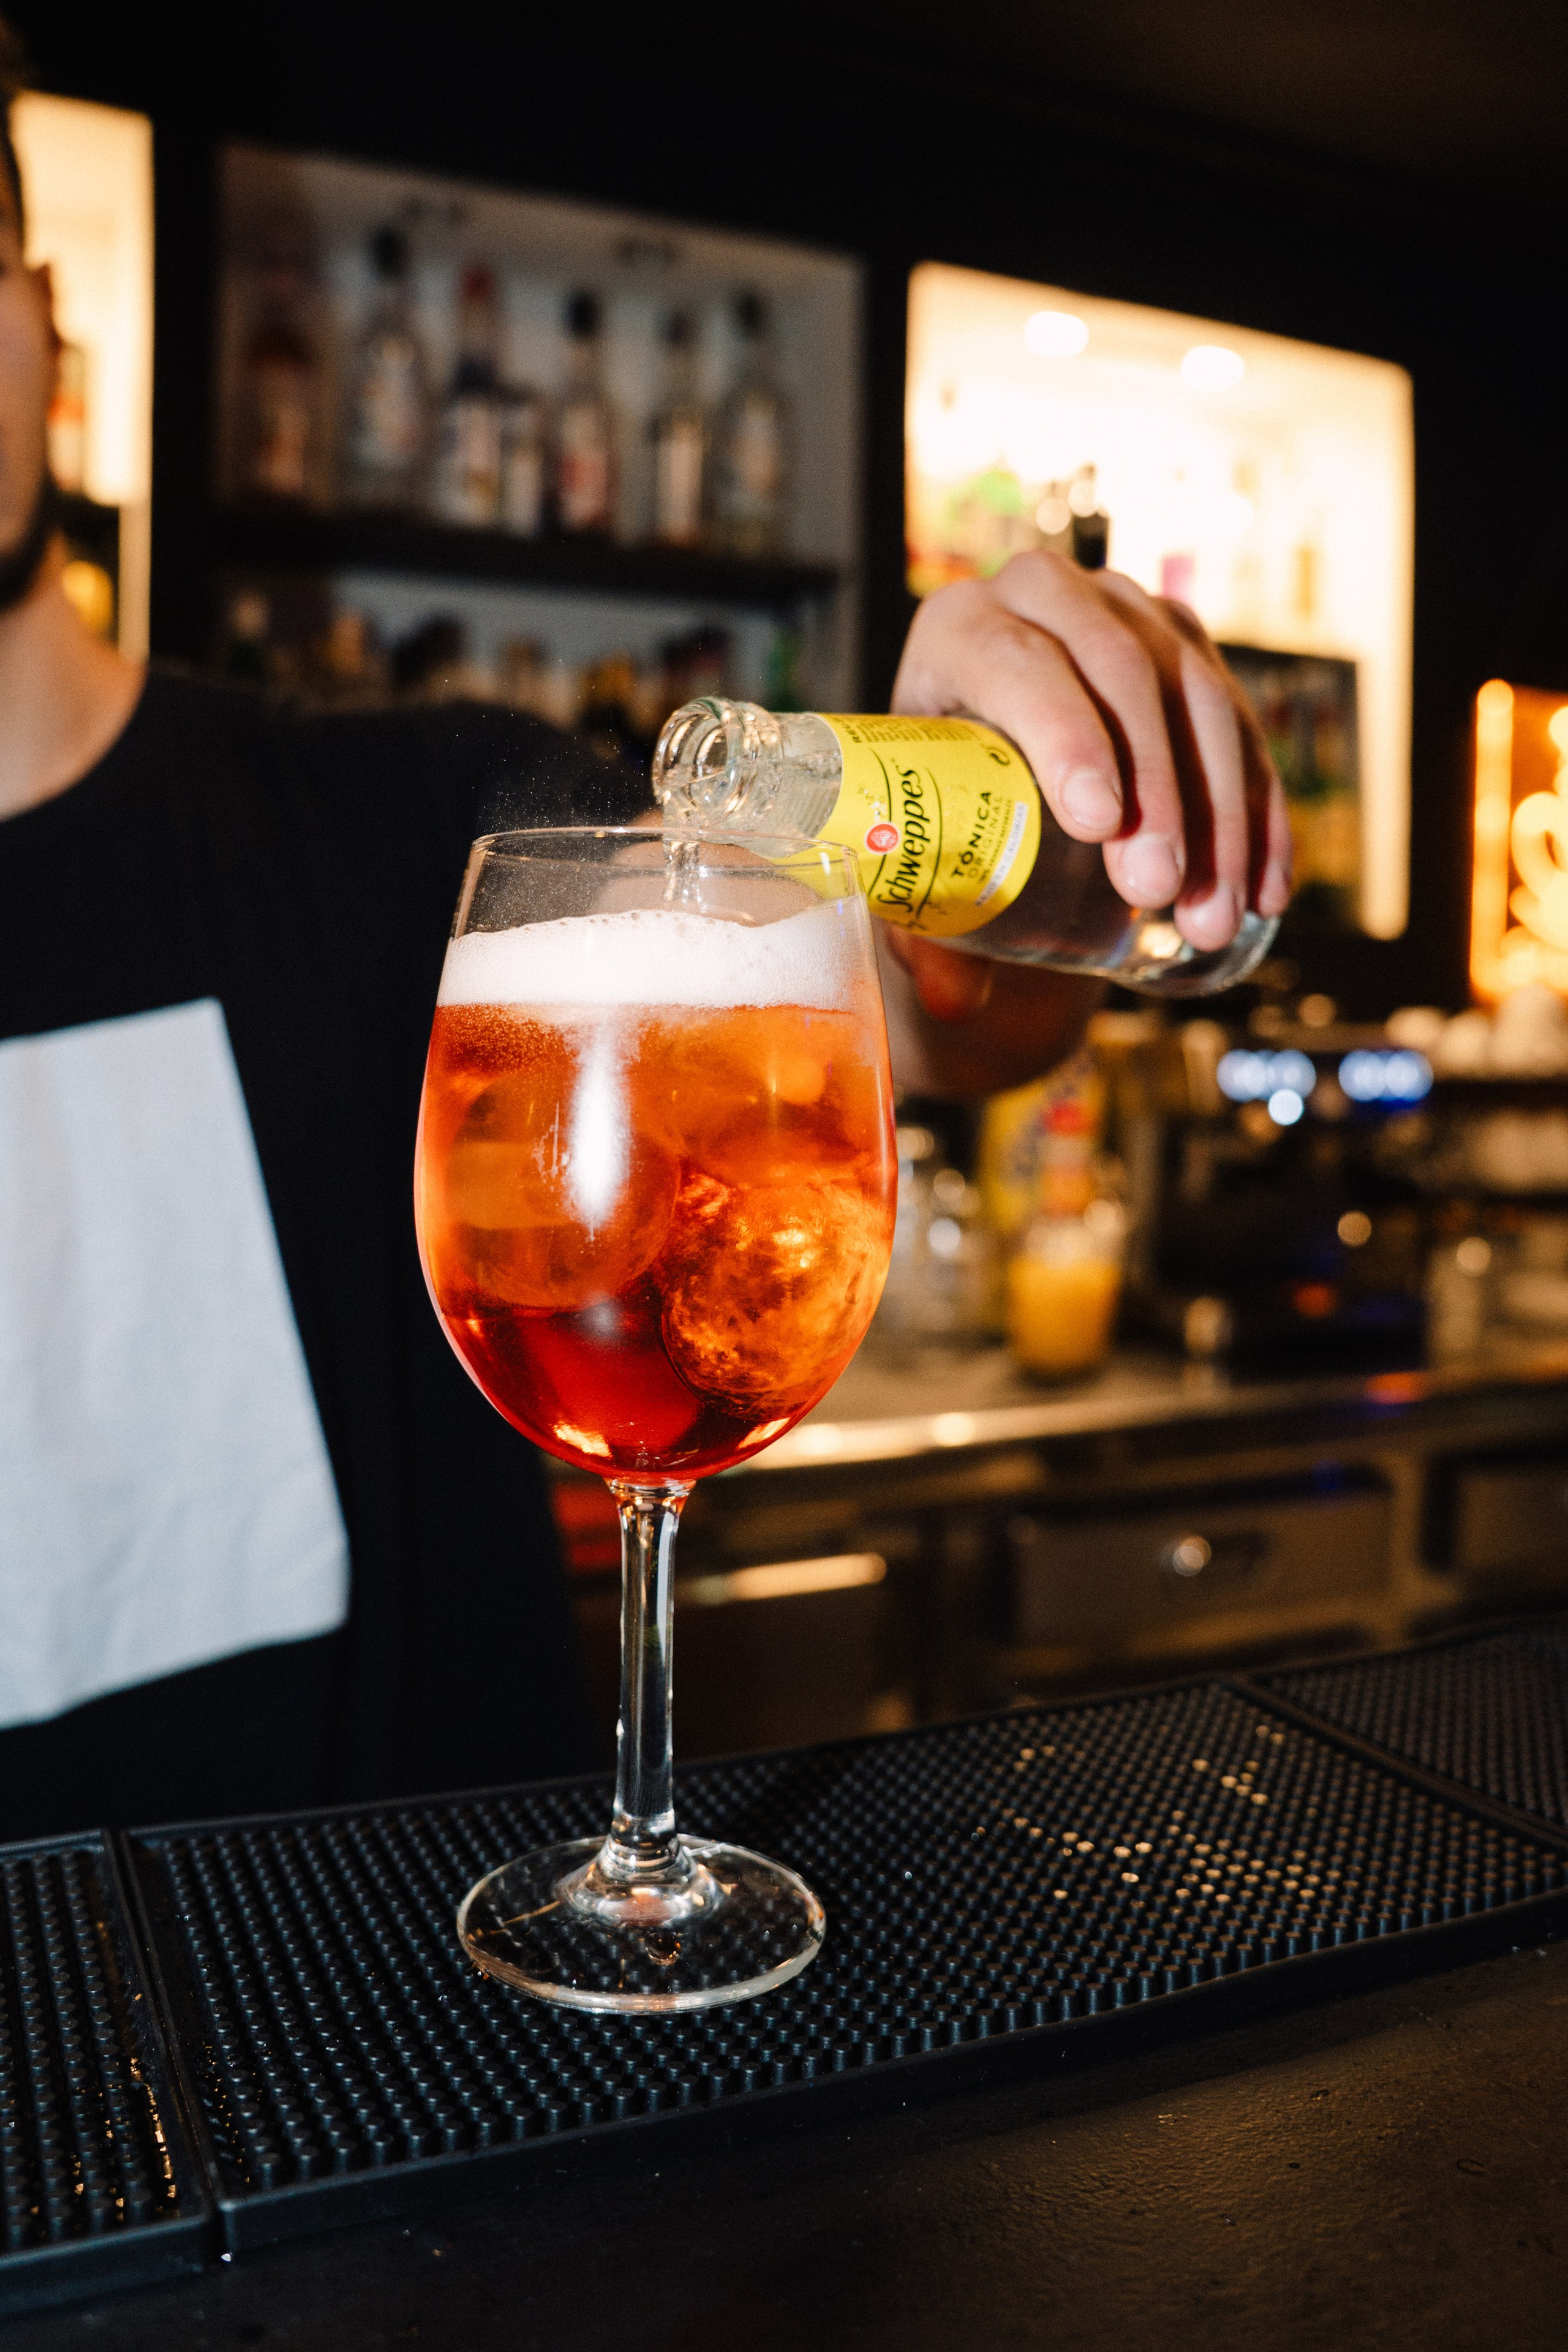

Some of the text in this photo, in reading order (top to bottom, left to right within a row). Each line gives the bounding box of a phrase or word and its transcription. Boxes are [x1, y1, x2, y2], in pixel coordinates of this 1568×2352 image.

[877, 765, 930, 913] Schweppes
[952, 791, 991, 876] TÓNICA
[968, 796, 1002, 878] ORIGINAL
